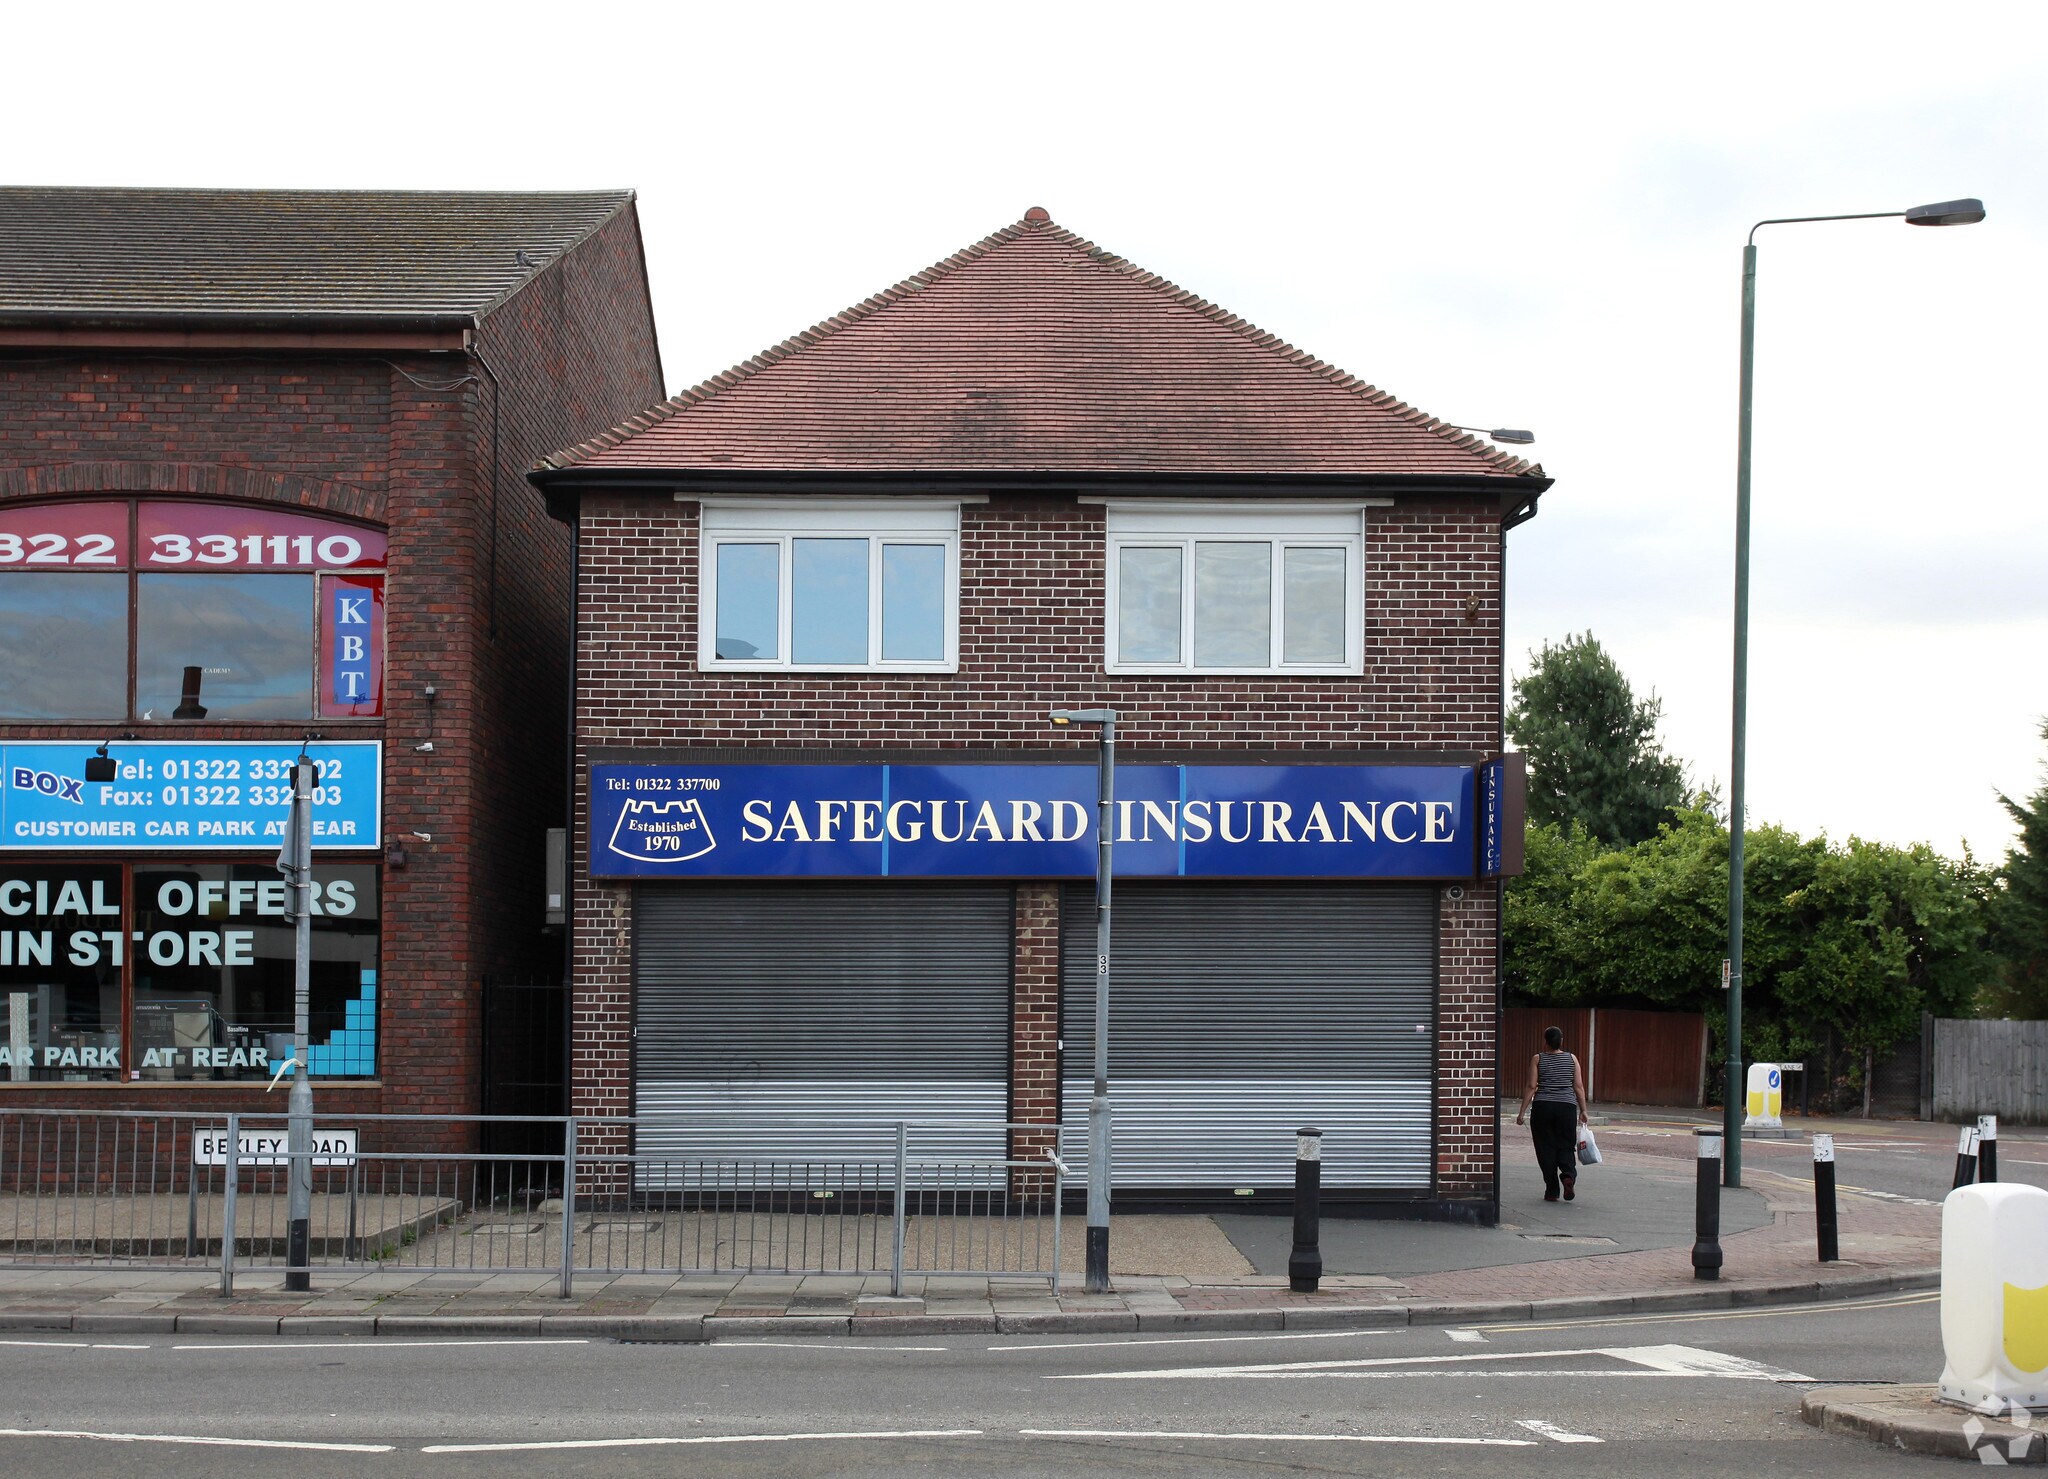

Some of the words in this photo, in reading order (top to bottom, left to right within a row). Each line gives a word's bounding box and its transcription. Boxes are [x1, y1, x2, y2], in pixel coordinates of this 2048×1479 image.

[149, 535, 362, 565] 331110
[339, 598, 367, 697] KBT
[162, 760, 241, 779] 01322
[249, 760, 342, 779] 33202
[13, 767, 84, 805] BOX
[606, 778, 631, 790] Tel:
[635, 778, 672, 791] 01322
[677, 778, 720, 791] 337700
[100, 786, 153, 806] Fax:
[162, 786, 240, 805] 01322
[249, 786, 342, 805] 33203
[15, 821, 136, 836] CUSTOMER
[145, 821, 189, 836] CAR
[199, 821, 256, 836] PARK
[263, 820, 288, 836] AT
[312, 820, 356, 836] EAR
[628, 818, 697, 833] Established
[742, 799, 1089, 843] SAFEGUARD
[1115, 799, 1455, 843] INSURANCE
[1487, 766, 1496, 870] INSURANCE
[645, 835, 680, 851] 1970
[0, 931, 52, 966] IN
[68, 931, 254, 967] STORE
[44, 1046, 120, 1067] PARK
[141, 1047, 178, 1067] AT
[192, 1047, 268, 1067] REAR
[307, 1139, 348, 1154] AD
